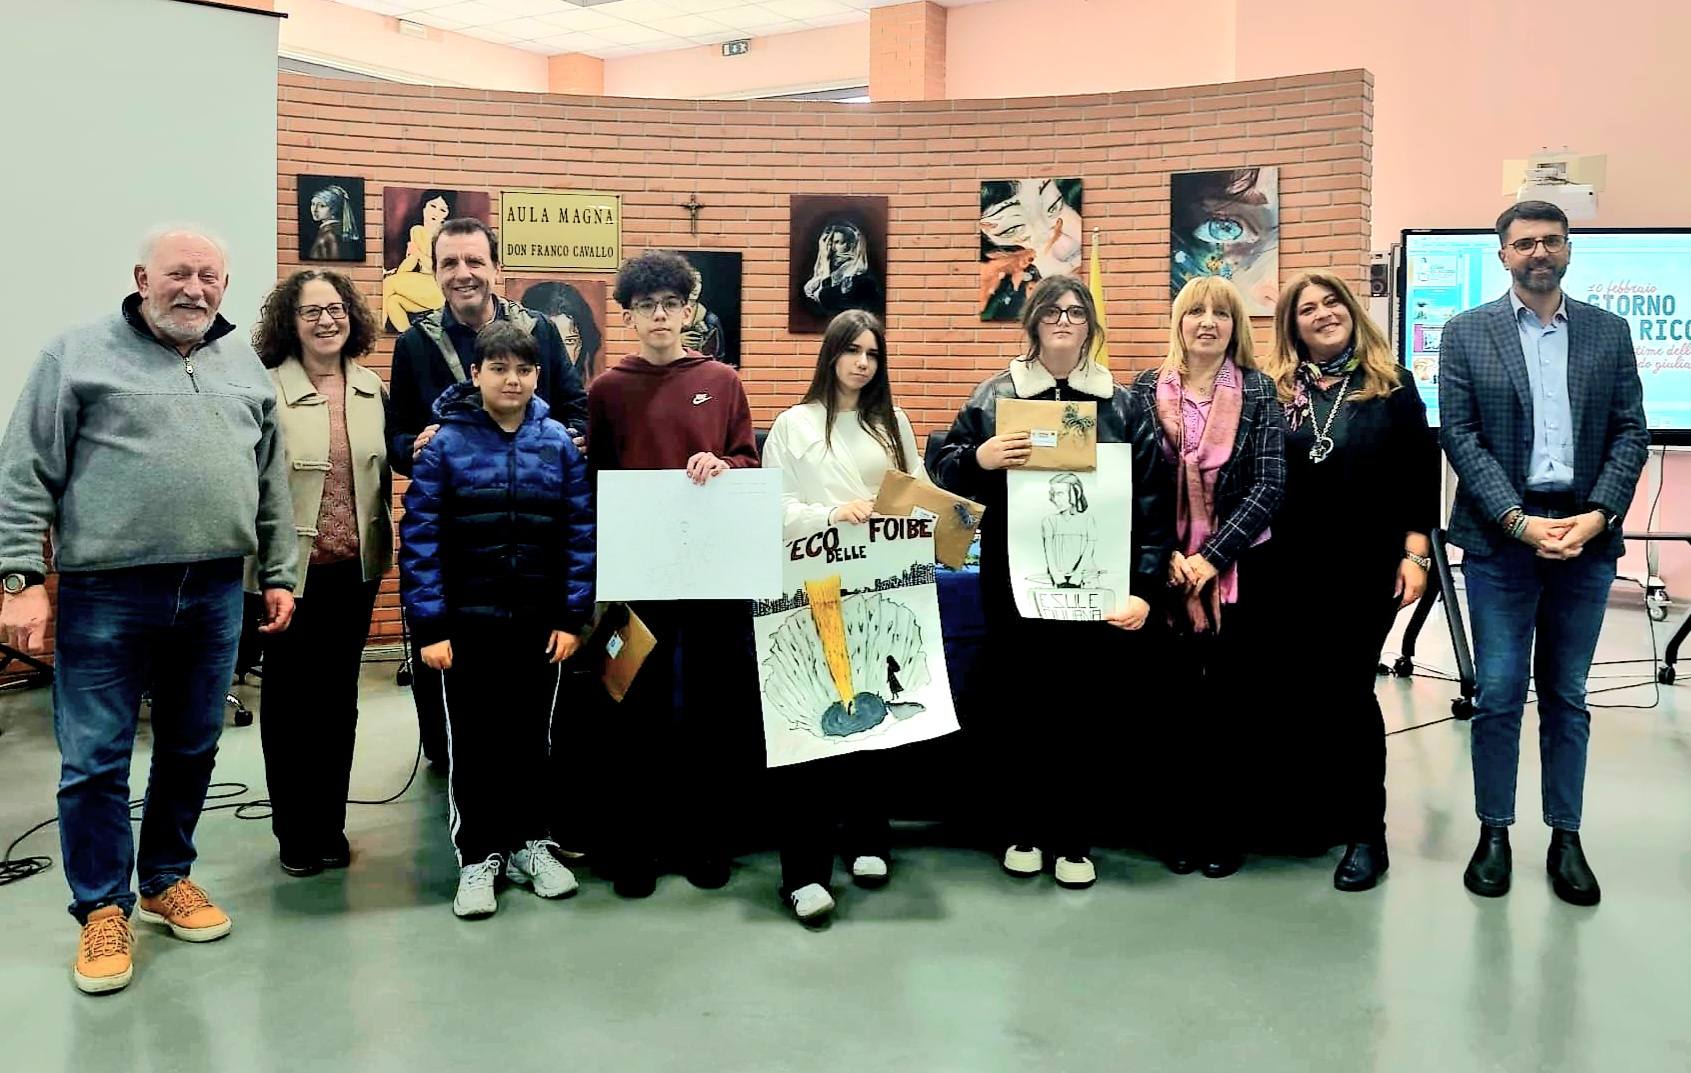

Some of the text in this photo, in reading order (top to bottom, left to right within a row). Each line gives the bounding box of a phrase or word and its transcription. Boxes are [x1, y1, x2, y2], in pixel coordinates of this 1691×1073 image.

[507, 206, 614, 224] AULA MAGNA
[507, 243, 614, 258] DON FRANCO CAVALLO
[1606, 279, 1657, 296] febbraio
[868, 517, 933, 542] FOIBE
